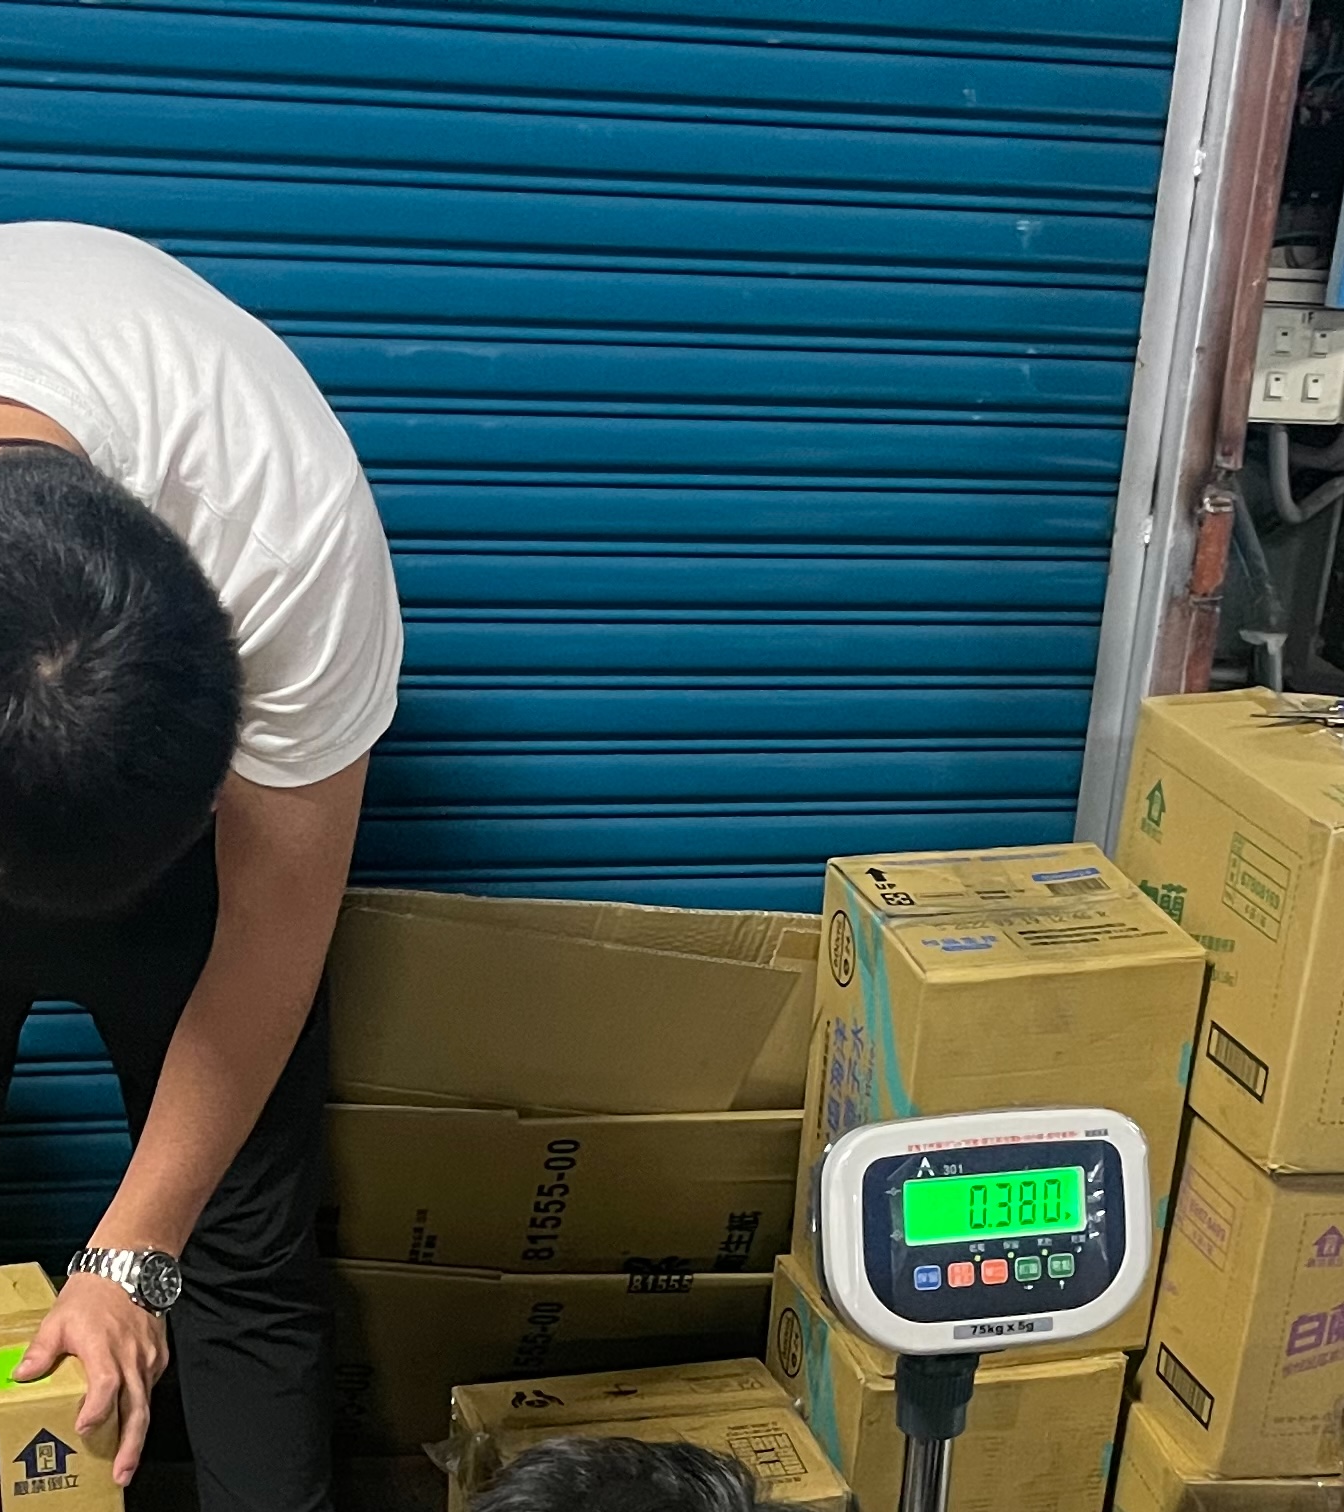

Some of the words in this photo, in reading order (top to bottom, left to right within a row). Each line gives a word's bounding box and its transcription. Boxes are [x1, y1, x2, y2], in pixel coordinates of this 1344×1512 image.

[521, 1138, 581, 1262] 81555-00
[969, 1178, 1062, 1230] 0.380
[629, 1274, 693, 1292] 81555
[970, 1321, 1004, 1338] 75kg
[1018, 1320, 1035, 1335] 5g
